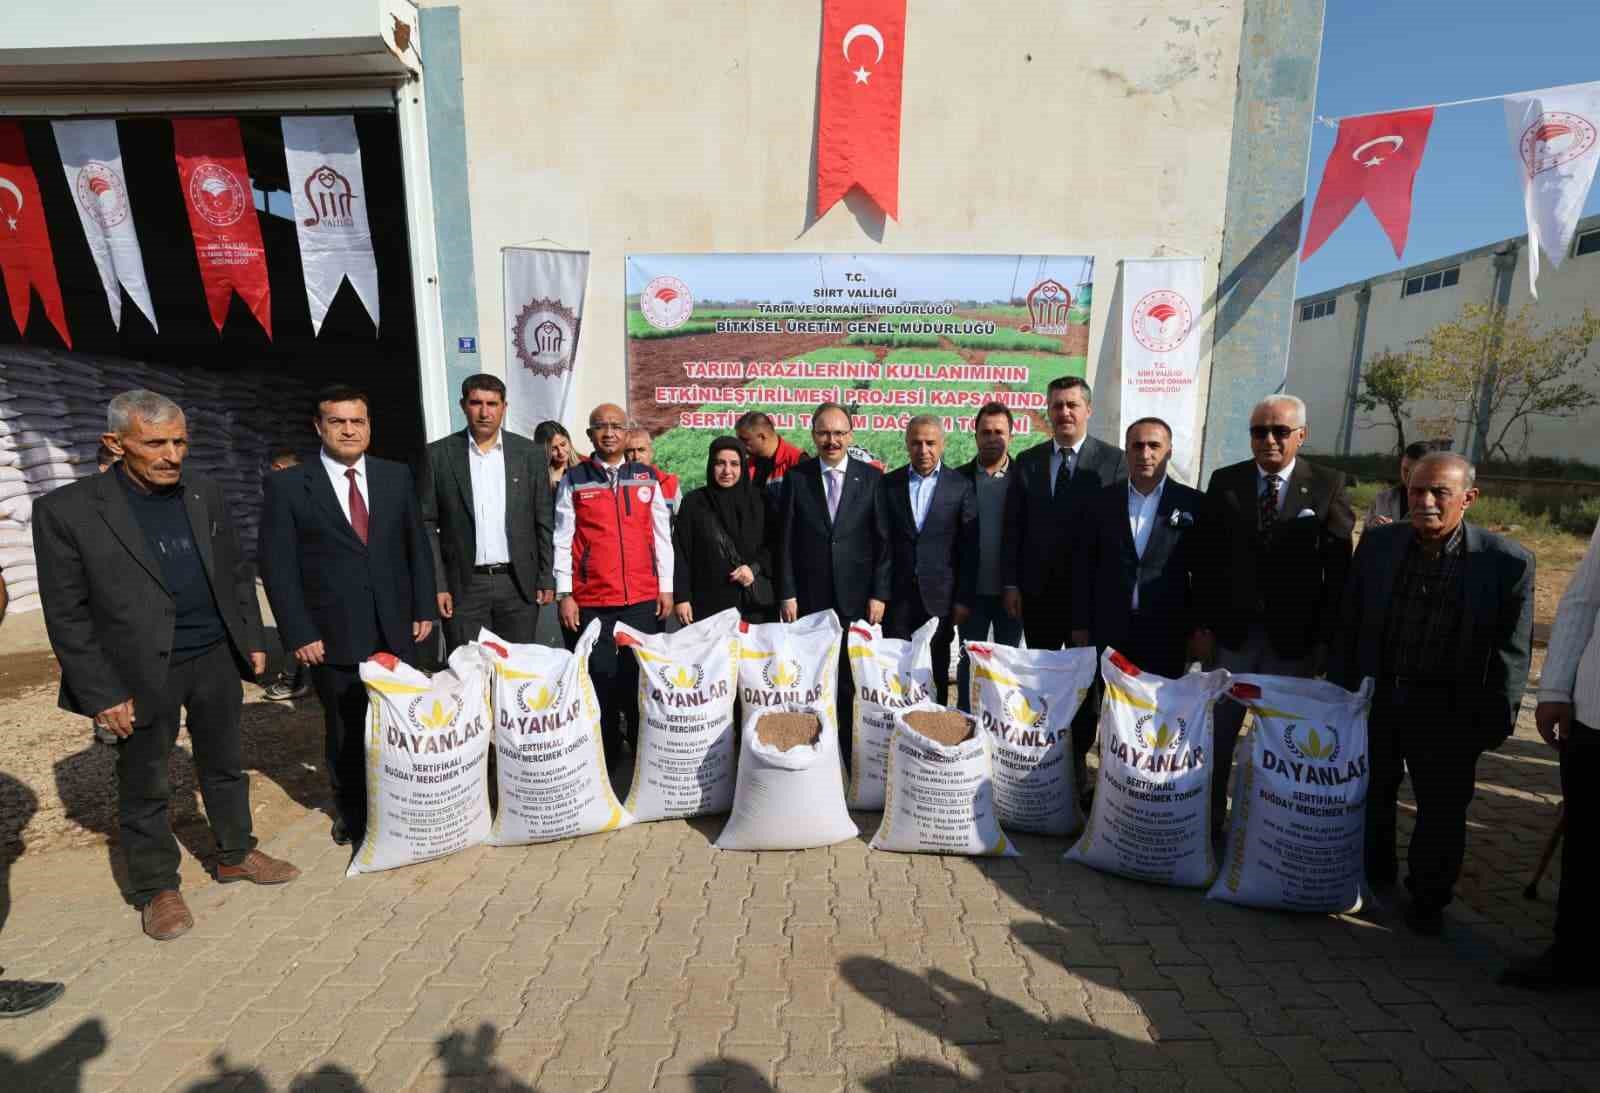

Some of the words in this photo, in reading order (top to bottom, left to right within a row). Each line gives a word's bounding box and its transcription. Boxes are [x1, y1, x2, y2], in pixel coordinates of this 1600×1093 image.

[845, 272, 866, 282] T.C.
[848, 287, 897, 298] VALİLİĞİ
[759, 304, 793, 313] TARIM
[799, 304, 814, 313] VE
[816, 304, 858, 314] ORMAN
[862, 302, 872, 314] İL
[877, 302, 952, 315] MÜDÜRLÜĞÜ
[717, 319, 783, 332] BİTKİSEL
[788, 319, 842, 333] ÜRETİM
[847, 321, 894, 333] GENEL
[900, 320, 994, 335] MÜDÜRLÜĞÜ
[685, 363, 742, 377] TARIM
[745, 361, 879, 378] ARAZİLERİNİN
[886, 364, 1027, 381] KULLANIMININ
[656, 385, 838, 405] ETKİNLEŞTİRİLMESİ
[845, 388, 925, 405] PROJESİ
[744, 683, 823, 707] DAYANLAR
[386, 714, 485, 754] DAYANLAR
[1110, 734, 1204, 773] DAYANLAR
